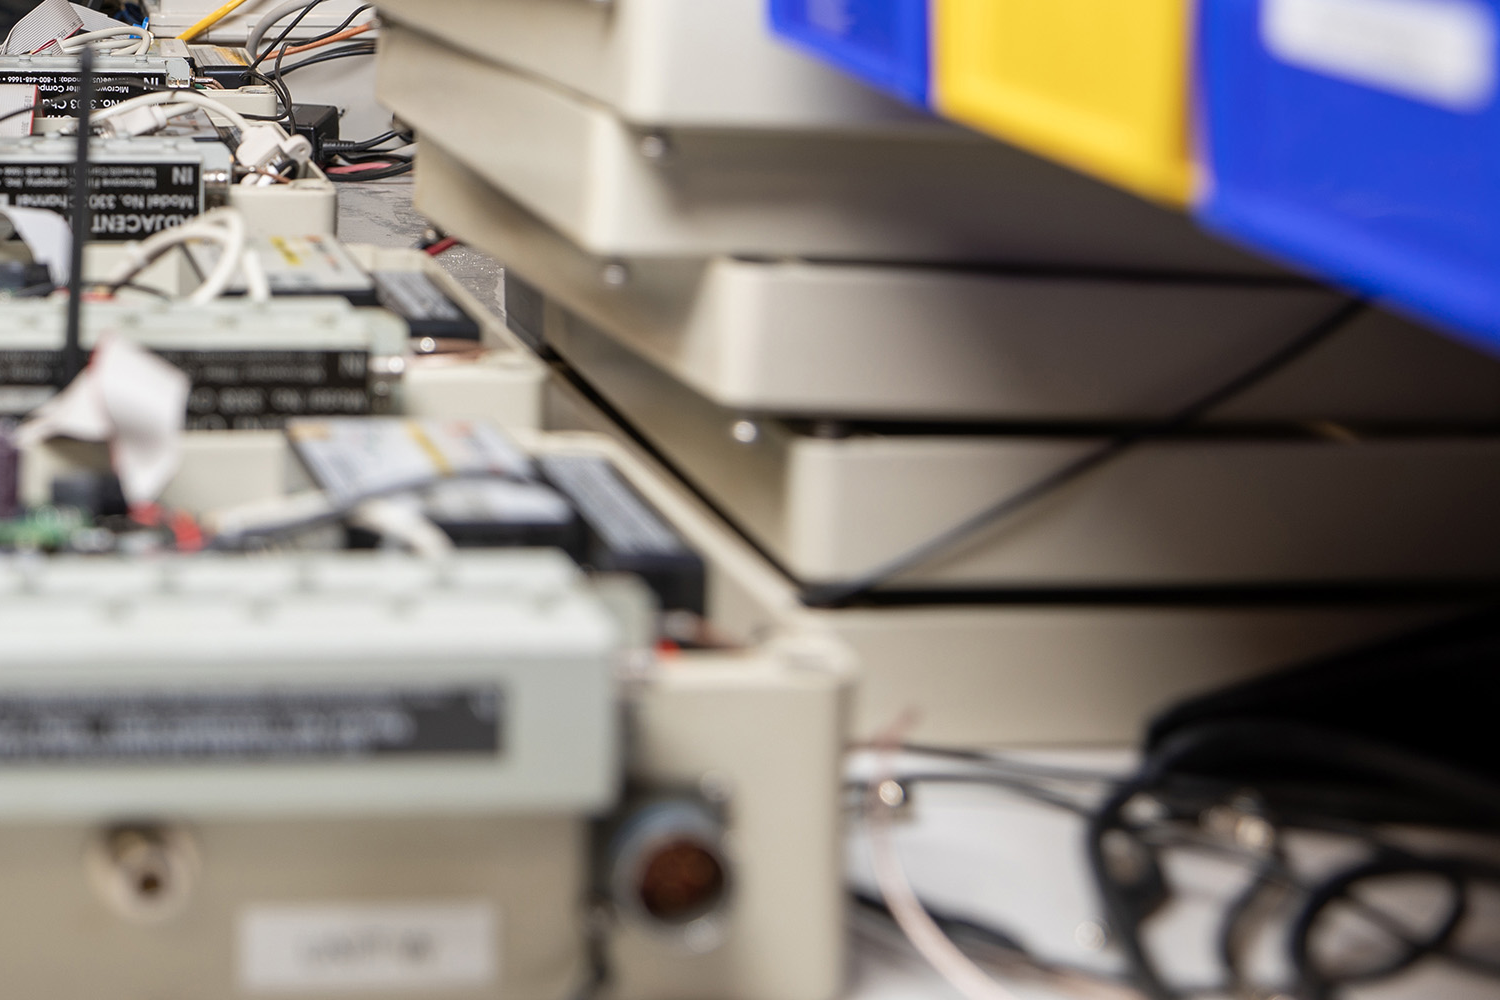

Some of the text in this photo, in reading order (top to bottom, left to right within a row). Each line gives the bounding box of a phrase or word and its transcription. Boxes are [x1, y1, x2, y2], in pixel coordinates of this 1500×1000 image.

[171, 166, 194, 185] IN
[84, 194, 117, 210] 330
[119, 194, 145, 210] No.
[147, 194, 194, 210] Model
